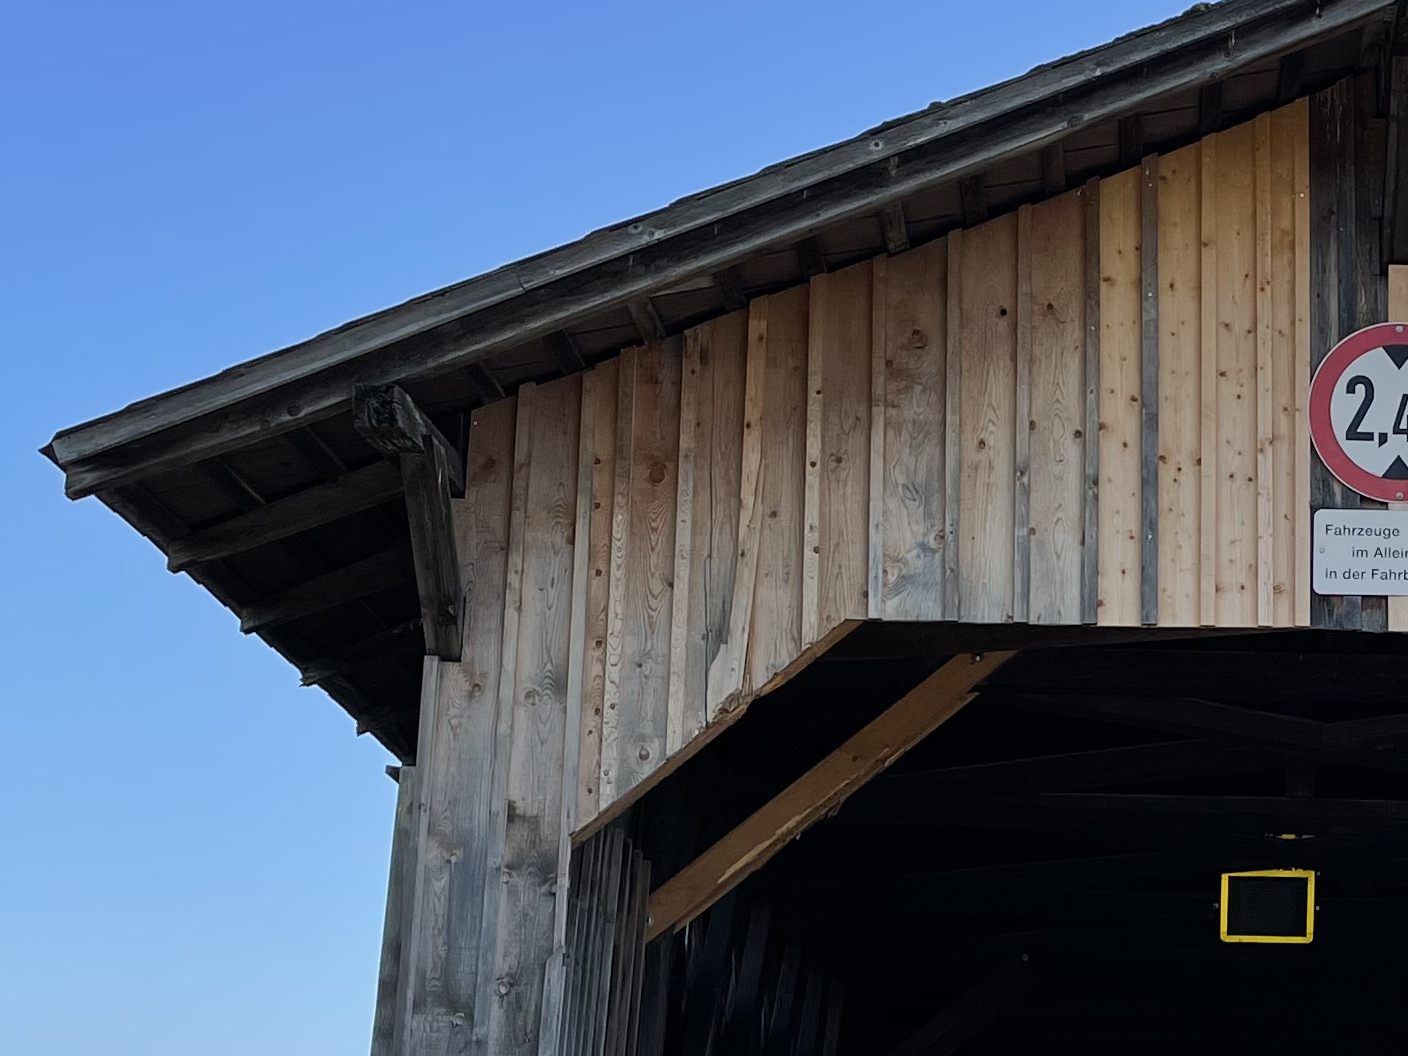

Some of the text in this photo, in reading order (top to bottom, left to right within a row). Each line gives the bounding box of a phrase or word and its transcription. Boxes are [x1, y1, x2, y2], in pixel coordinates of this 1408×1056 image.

[1325, 524, 1400, 539] Fahrzeuge
[1351, 546, 1368, 559] im
[1325, 568, 1338, 580] in
[1342, 568, 1367, 581] der
